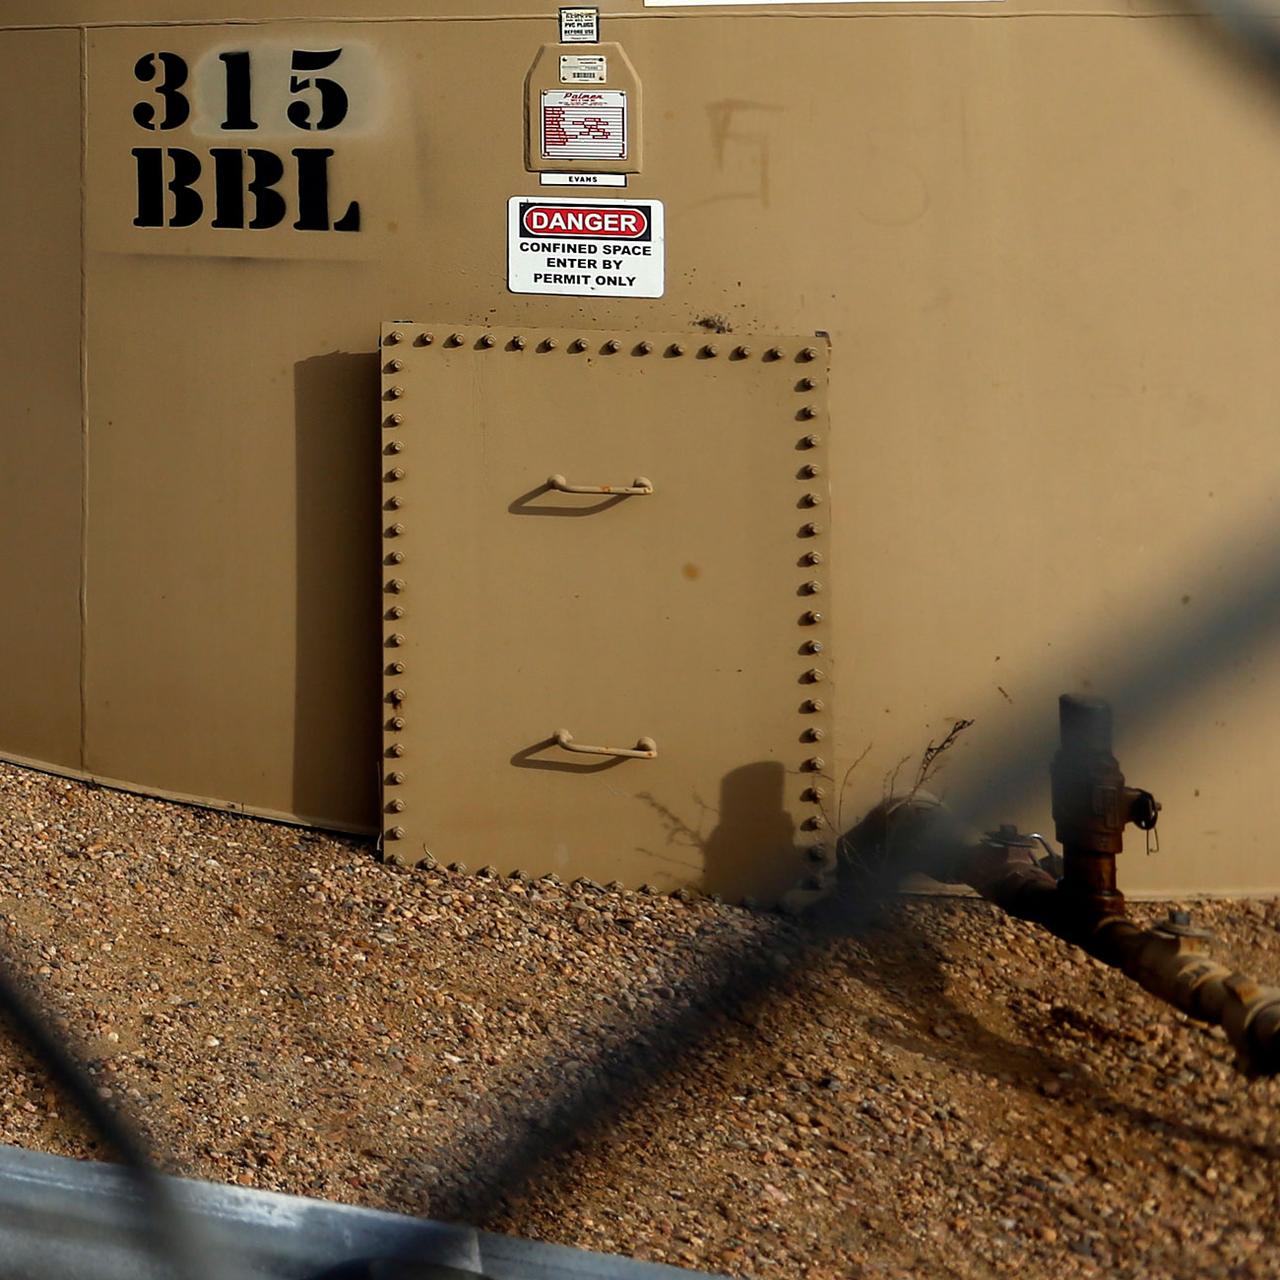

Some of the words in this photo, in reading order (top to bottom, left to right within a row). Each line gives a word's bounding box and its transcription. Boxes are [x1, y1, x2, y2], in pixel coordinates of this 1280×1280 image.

[133, 49, 349, 131] 315
[132, 148, 360, 233] BBL
[532, 211, 638, 232] DANGER
[519, 242, 598, 254] CONFINED
[602, 245, 652, 256] SPACE
[546, 258, 598, 269] ENTER
[602, 260, 623, 270] BY
[533, 273, 591, 285] PERMIT
[595, 276, 637, 287] ONLY
